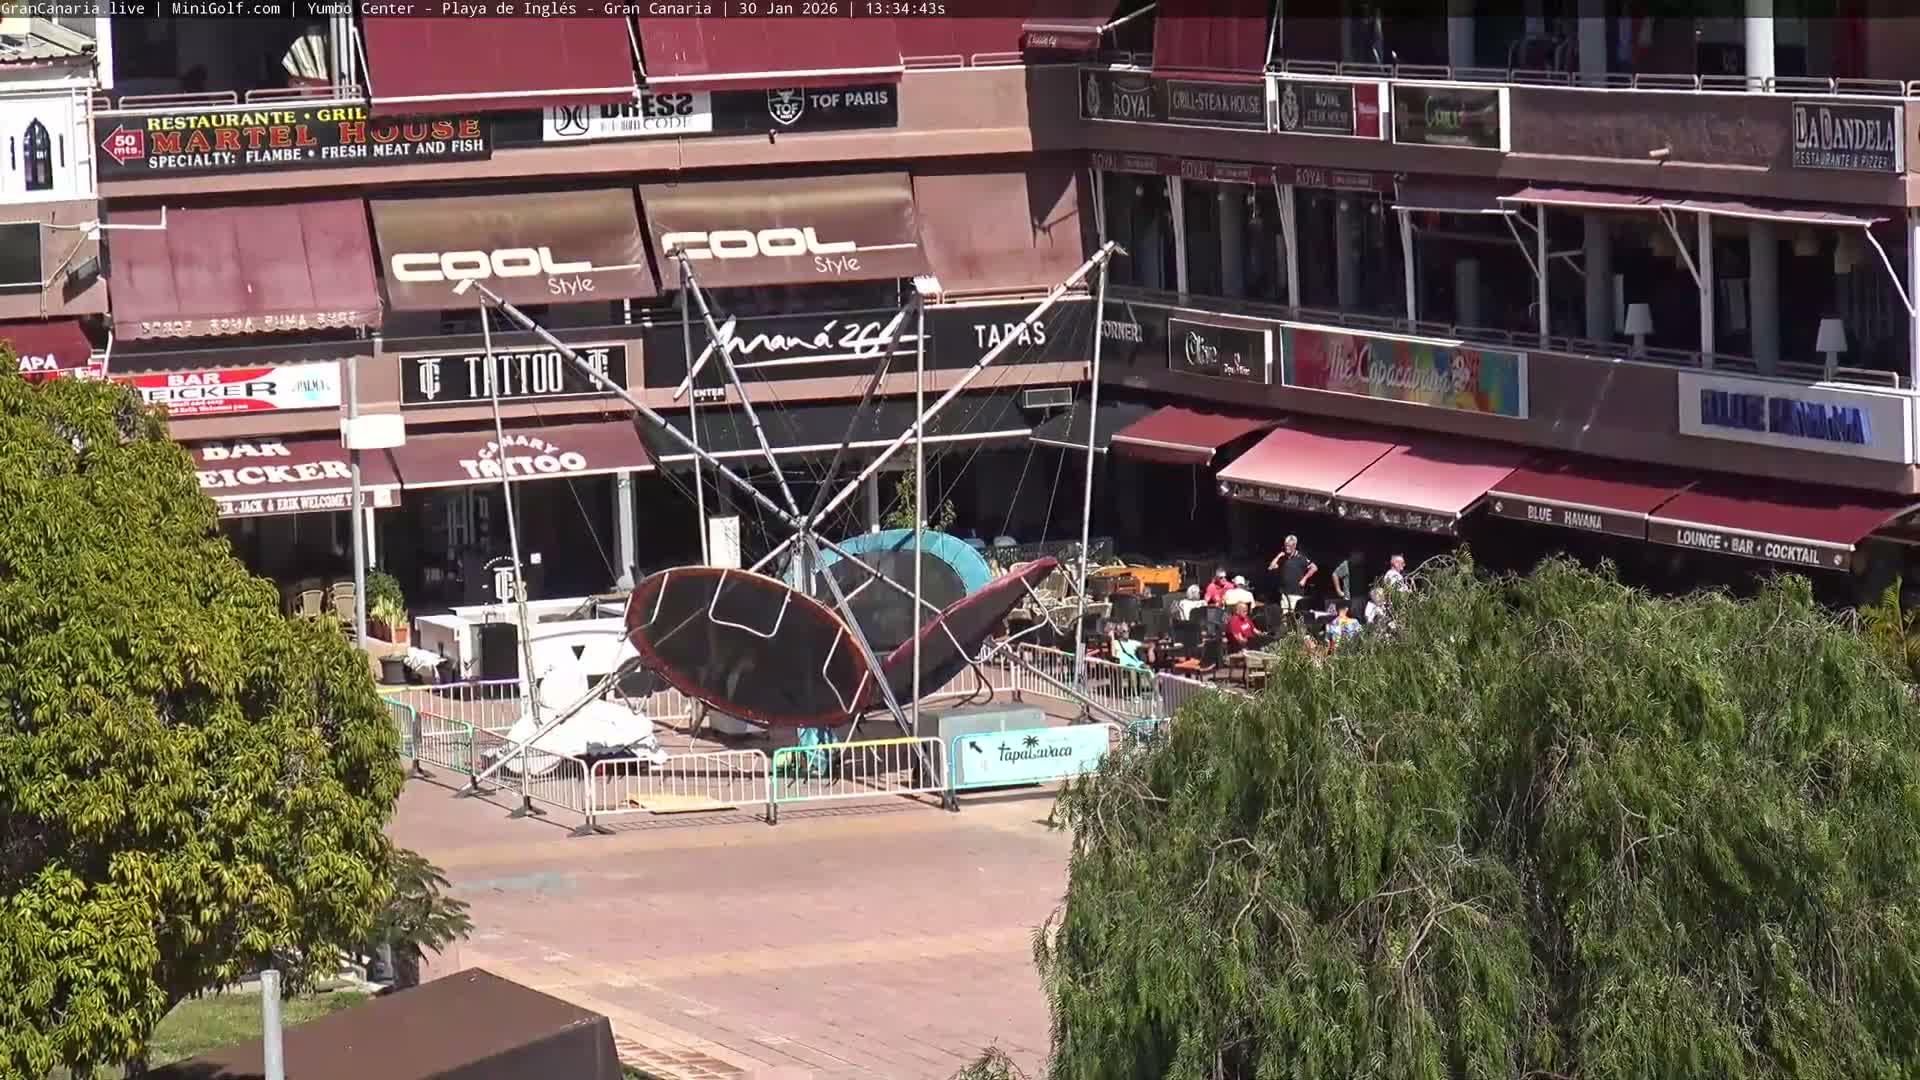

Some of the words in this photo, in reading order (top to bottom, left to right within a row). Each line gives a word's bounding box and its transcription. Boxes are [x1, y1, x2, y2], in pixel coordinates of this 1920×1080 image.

[774, 103, 799, 116] TOF
[810, 94, 841, 108] TOF
[845, 91, 889, 106] PARIS
[1113, 93, 1157, 119] ROYAL
[1230, 95, 1262, 113] HOUSE
[147, 111, 297, 131] RESTAURANTE
[115, 136, 135, 147] 50
[152, 124, 317, 154] MARTEL
[339, 120, 481, 144] HOUSE
[113, 146, 142, 155] mts.
[149, 152, 236, 169] SPECIALTY:
[245, 148, 302, 164] FLAMBE
[321, 144, 367, 160] FRESH
[373, 143, 411, 157] MEAT
[415, 141, 446, 155] AND
[451, 139, 484, 153] FISH
[1861, 155, 1894, 169] PIZZER
[660, 227, 857, 260] COOL
[391, 247, 592, 282] COOL
[813, 255, 861, 275] Style
[548, 276, 596, 296] Style
[974, 320, 1047, 348] TAPAS
[16, 353, 58, 371] APA
[1326, 342, 1353, 380] The
[1358, 342, 1450, 392] Copacabana
[167, 372, 220, 387] BAR
[464, 352, 564, 399] TATTOO
[138, 381, 277, 402] EICKER
[694, 387, 724, 397] ENTER
[202, 442, 291, 460] BAR
[478, 435, 560, 459] CANARY
[459, 451, 588, 478] TATTOO
[239, 500, 264, 514] JACK
[267, 498, 274, 512] &
[276, 496, 299, 511] ERIK
[300, 494, 345, 510] WELCOME
[345, 492, 366, 507] YU
[1527, 504, 1553, 522] BLUE
[1564, 510, 1603, 530] HAVANA
[1677, 529, 1721, 550] LOUNGE
[1731, 537, 1753, 554] BAR
[1764, 542, 1820, 565] COCKTAIL
